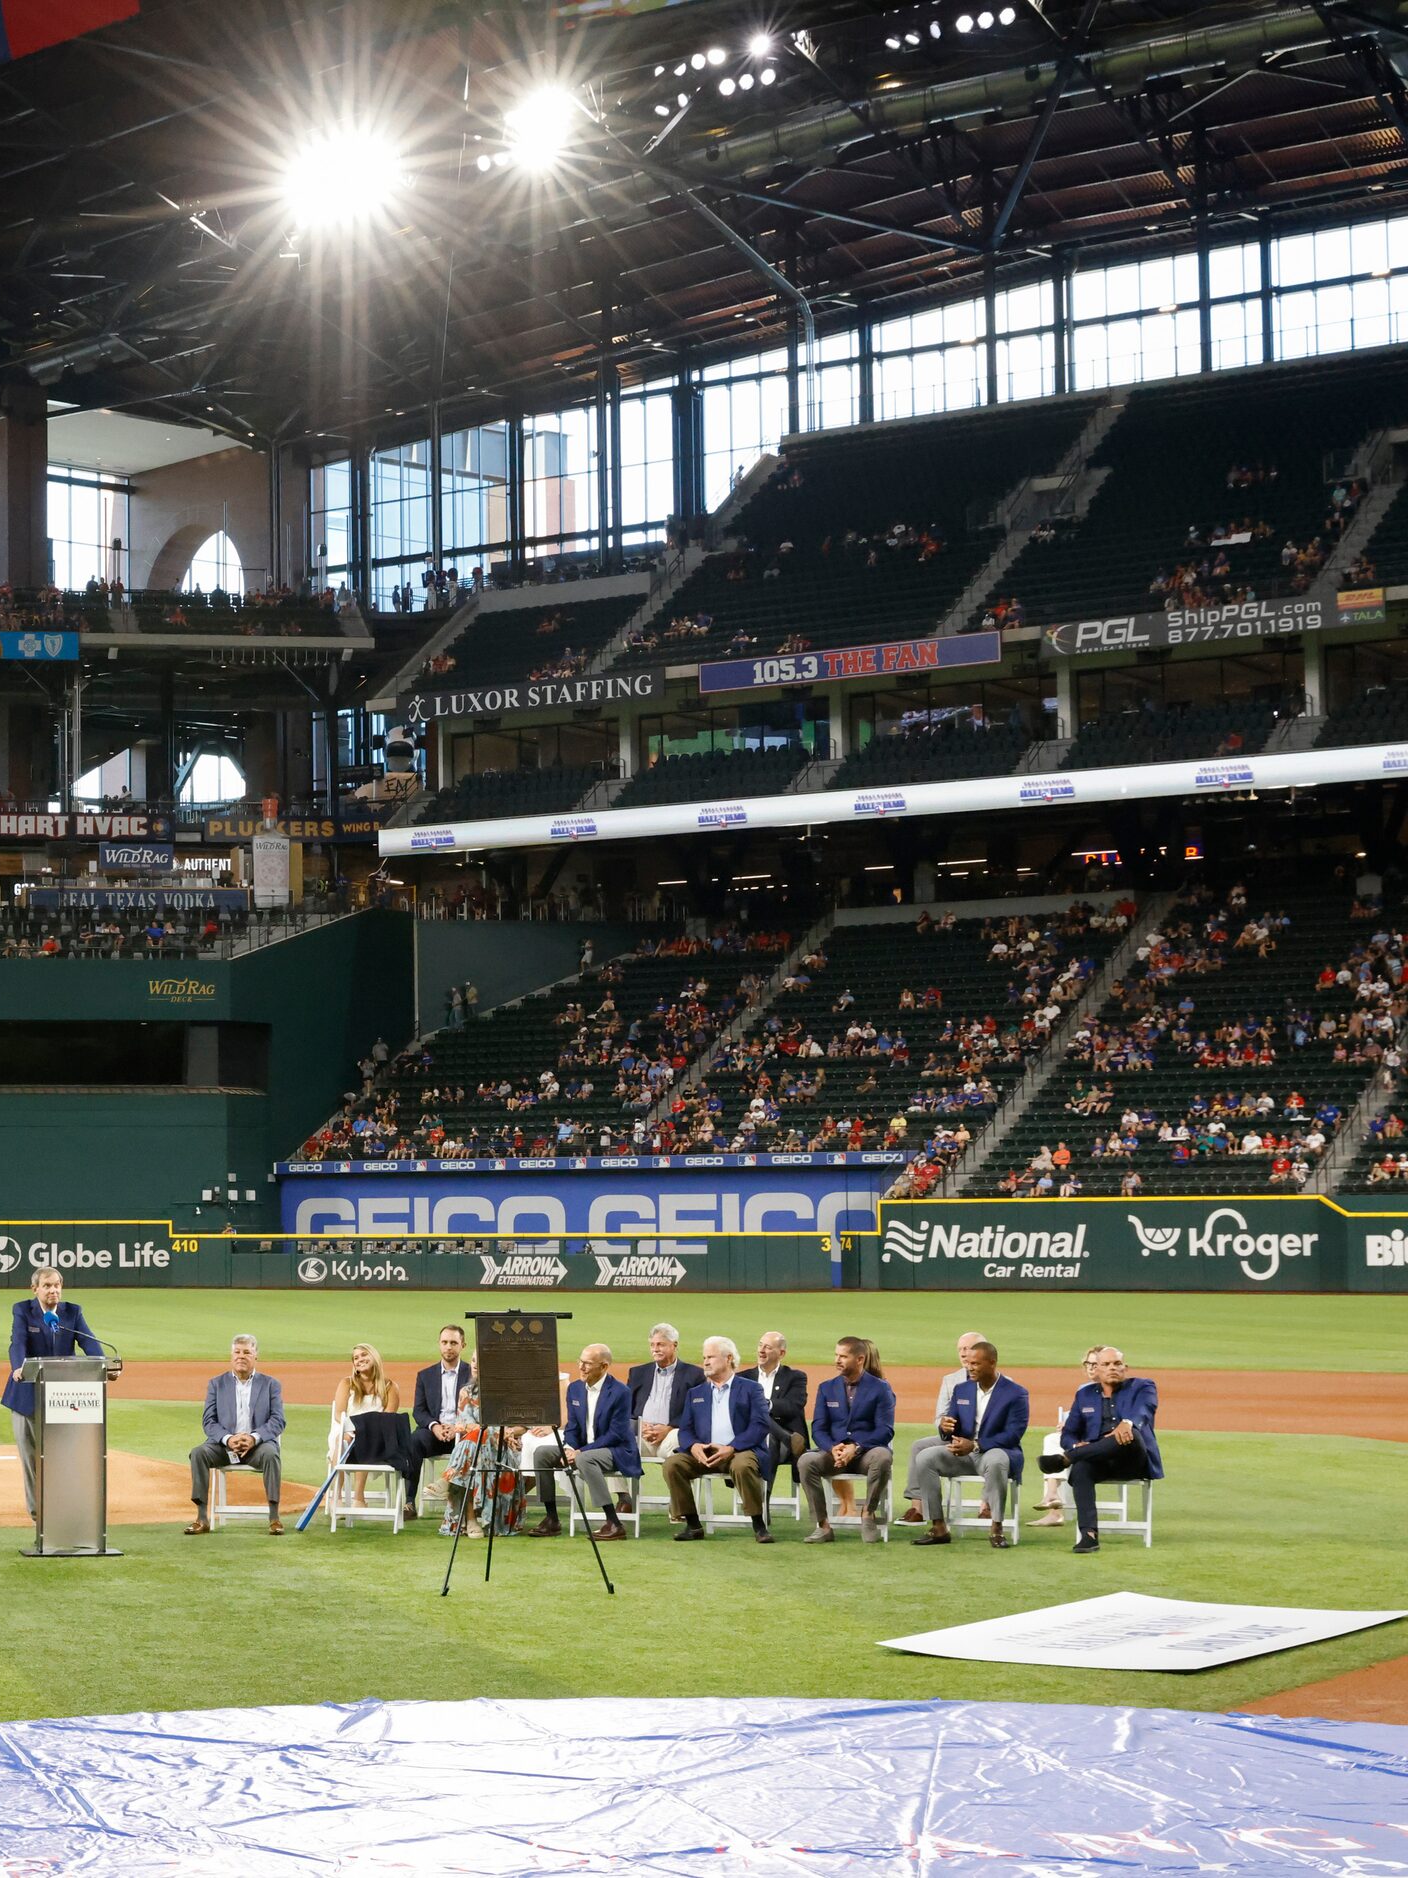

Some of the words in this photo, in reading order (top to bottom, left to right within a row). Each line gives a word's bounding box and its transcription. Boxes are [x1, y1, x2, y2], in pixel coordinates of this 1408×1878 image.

[1167, 601, 1322, 627] ShipPGL.com
[1076, 617, 1150, 648] PGL
[1168, 616, 1322, 644] 877.701.1919
[753, 655, 818, 684] 105.3
[823, 650, 877, 676] THE
[882, 641, 939, 670] FAN
[434, 689, 520, 716] LUXOR
[528, 674, 653, 707] STAFFING
[0, 815, 68, 838] HART
[76, 815, 148, 837] HVAC
[342, 823, 371, 833] WING
[105, 848, 142, 864] WILD
[142, 850, 169, 864] RAG
[105, 893, 157, 910] TEXAS
[164, 893, 215, 910] VODKA
[148, 978, 188, 995] WILD
[187, 981, 216, 995] RAG
[363, 1162, 398, 1171] GEICO
[440, 1161, 476, 1170] GEICO
[519, 1159, 556, 1169] GEICO
[601, 1158, 638, 1167] GEICO
[685, 1157, 724, 1166] GEICO
[771, 1154, 812, 1164] GEICO
[862, 1153, 903, 1163] GEICO
[289, 1164, 322, 1172] GEICO
[296, 1196, 566, 1254] GEICO
[588, 1192, 879, 1254] GEICO
[172, 1240, 198, 1253] 410
[929, 1224, 1087, 1259] National
[28, 1241, 113, 1268] Globe
[119, 1241, 170, 1268] Life
[332, 1260, 407, 1281] Kubota
[503, 1256, 555, 1275] ARROW
[617, 1256, 674, 1275] ARROW
[983, 1263, 1015, 1278] Car
[1020, 1263, 1081, 1278] Rental
[497, 1276, 554, 1286] EXTERMINATORS
[613, 1276, 672, 1286] EXTERMINATORS
